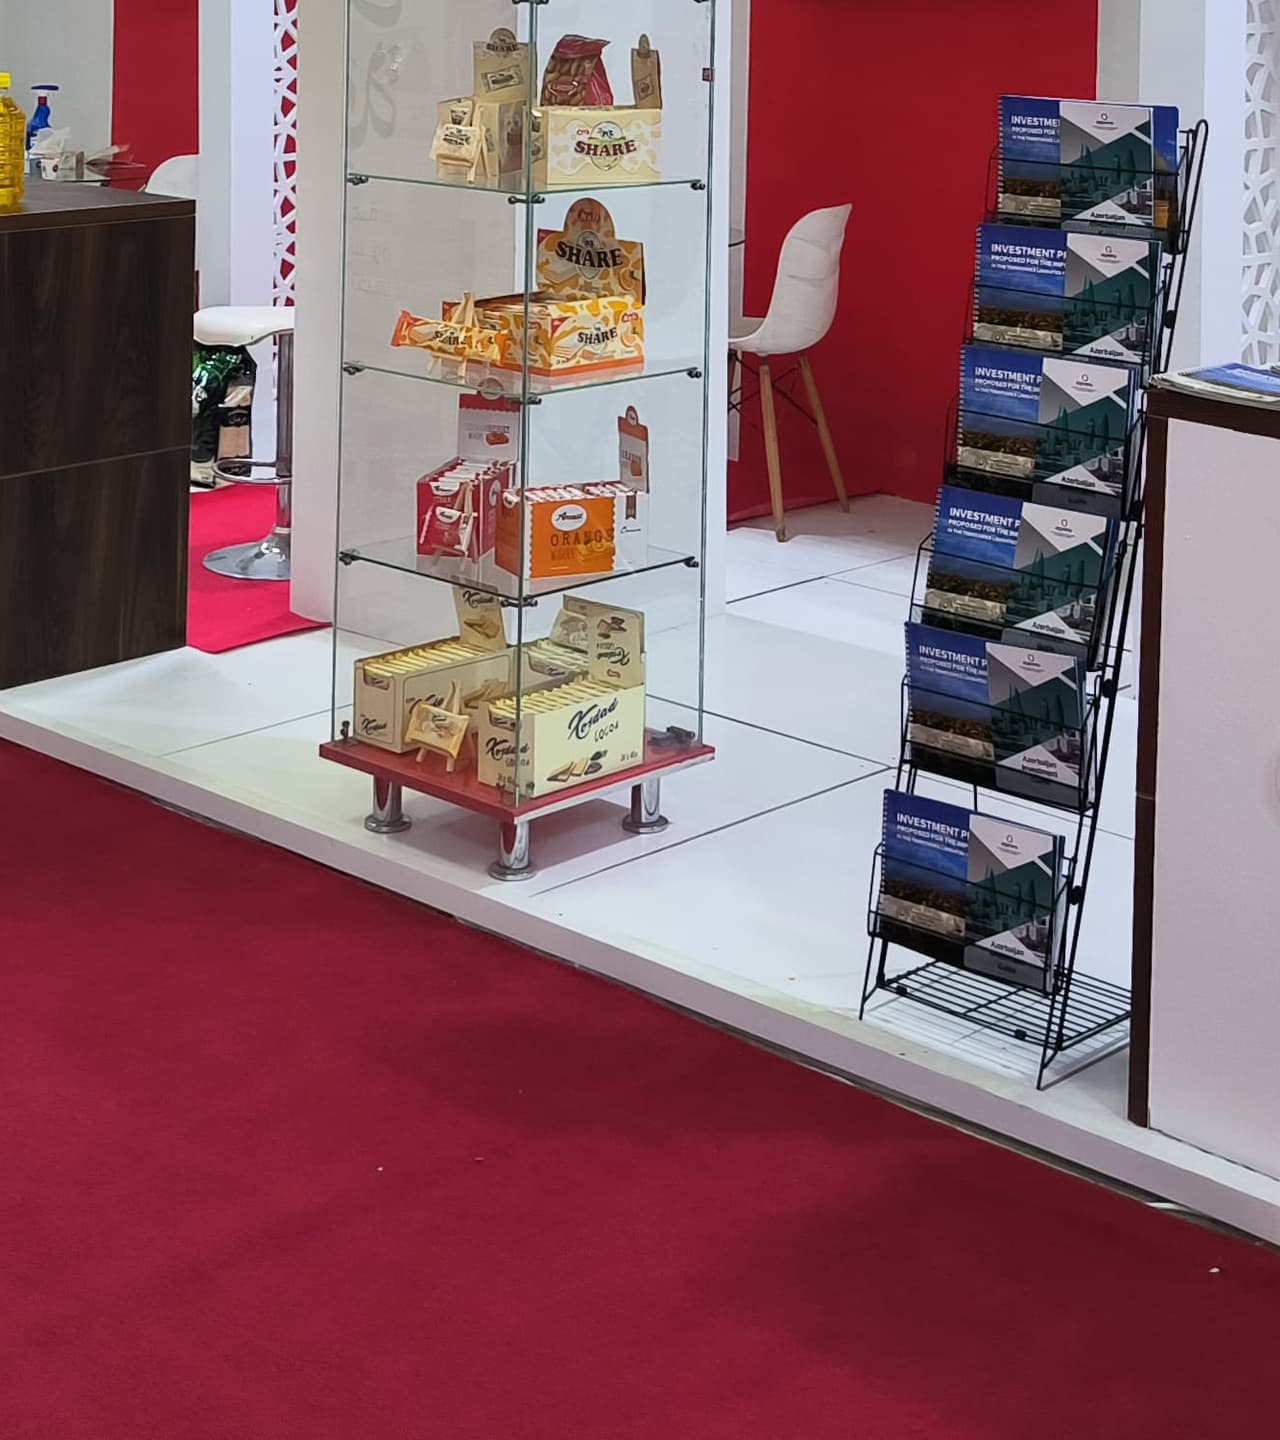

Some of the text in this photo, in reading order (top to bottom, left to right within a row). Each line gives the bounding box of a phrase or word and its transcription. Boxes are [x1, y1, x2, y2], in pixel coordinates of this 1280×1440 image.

[574, 139, 638, 158] SHARE
[555, 240, 624, 269] SHARE
[991, 243, 1055, 258] INVESTMENT
[577, 326, 619, 346] SHARE
[975, 366, 1035, 383] INVESTMENT
[949, 506, 1013, 527] INVESTMENT
[919, 644, 980, 666] INVESTMENT
[897, 812, 959, 838] INVESTMENT
